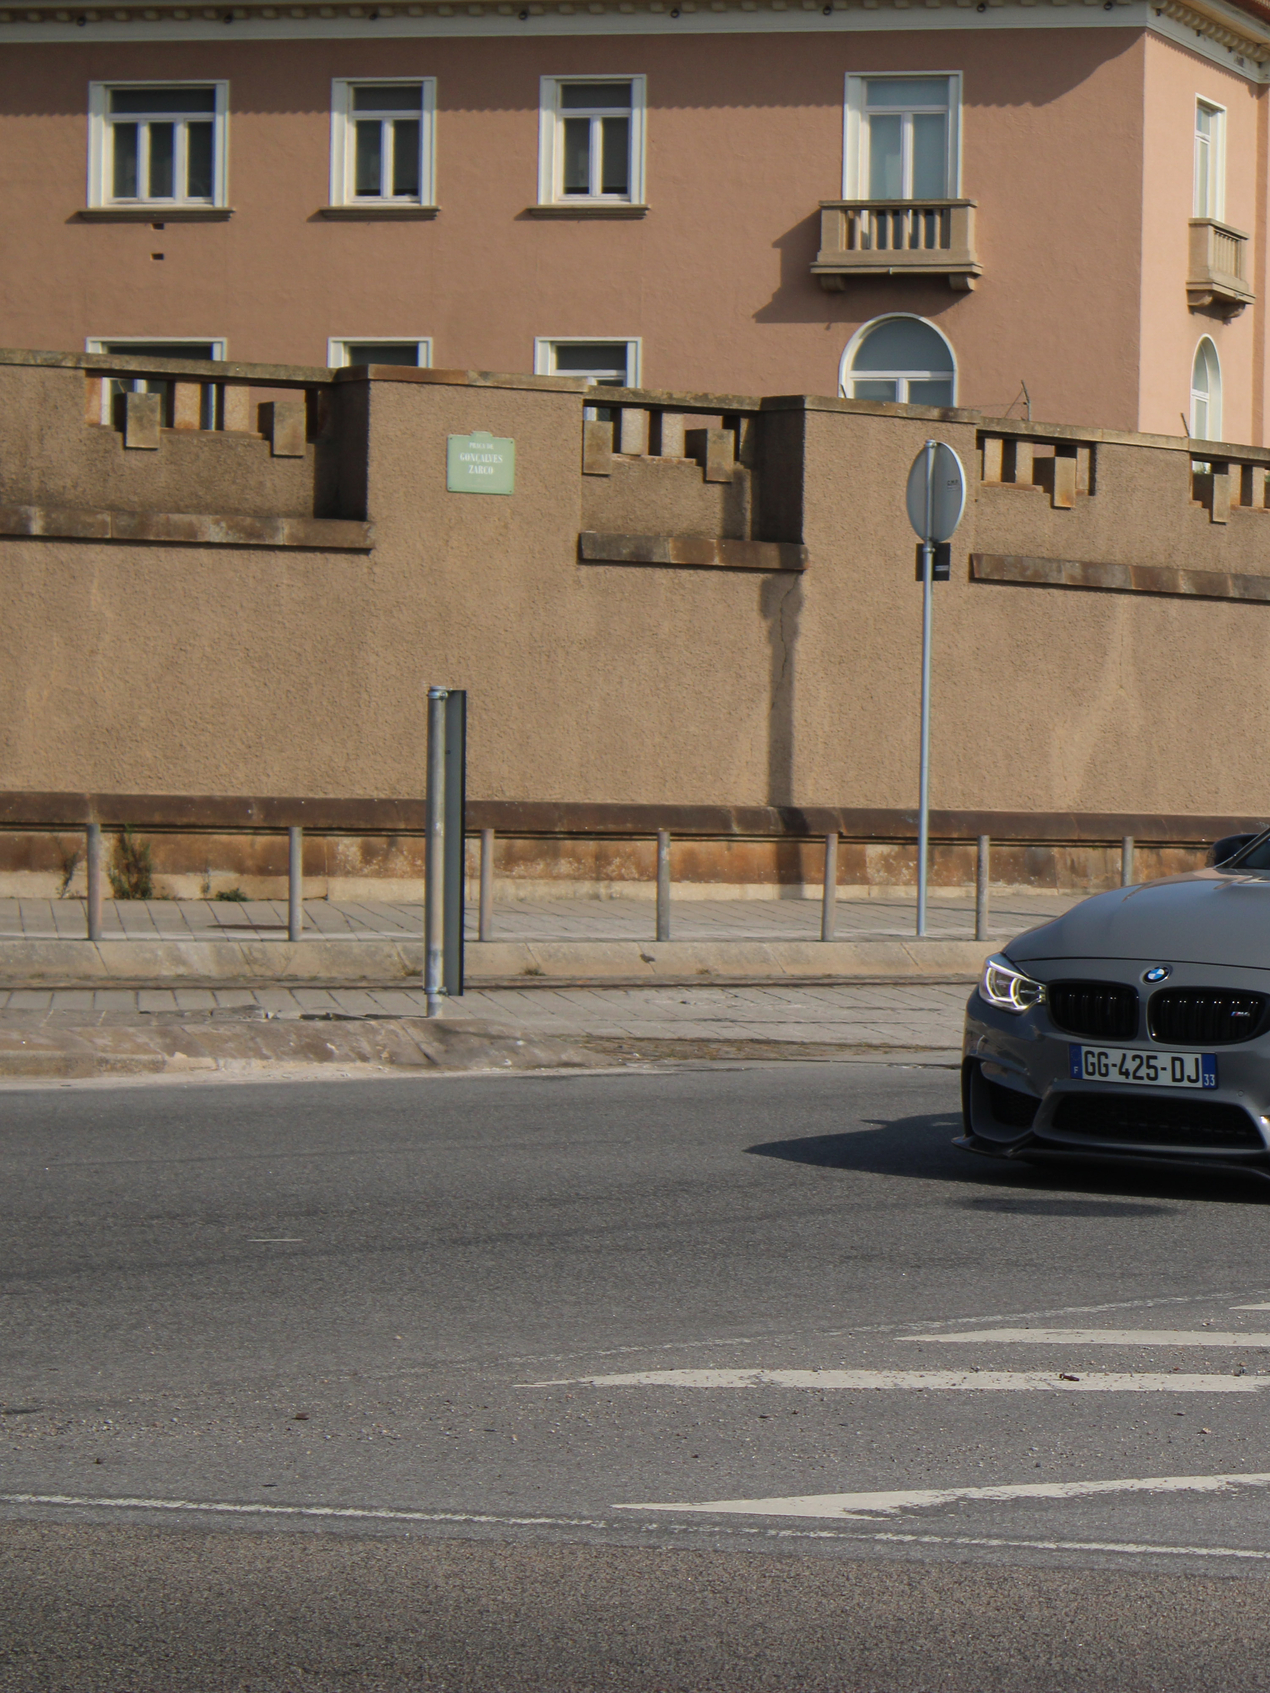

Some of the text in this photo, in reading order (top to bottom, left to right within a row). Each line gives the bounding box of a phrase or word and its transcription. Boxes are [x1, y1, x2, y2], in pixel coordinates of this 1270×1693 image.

[459, 452, 503, 464] GONÇALVES
[468, 464, 494, 475] ZARCO
[1073, 1066, 1079, 1074] F
[1084, 1050, 1200, 1084] GG-425-DJ
[1203, 1073, 1216, 1087] 33
